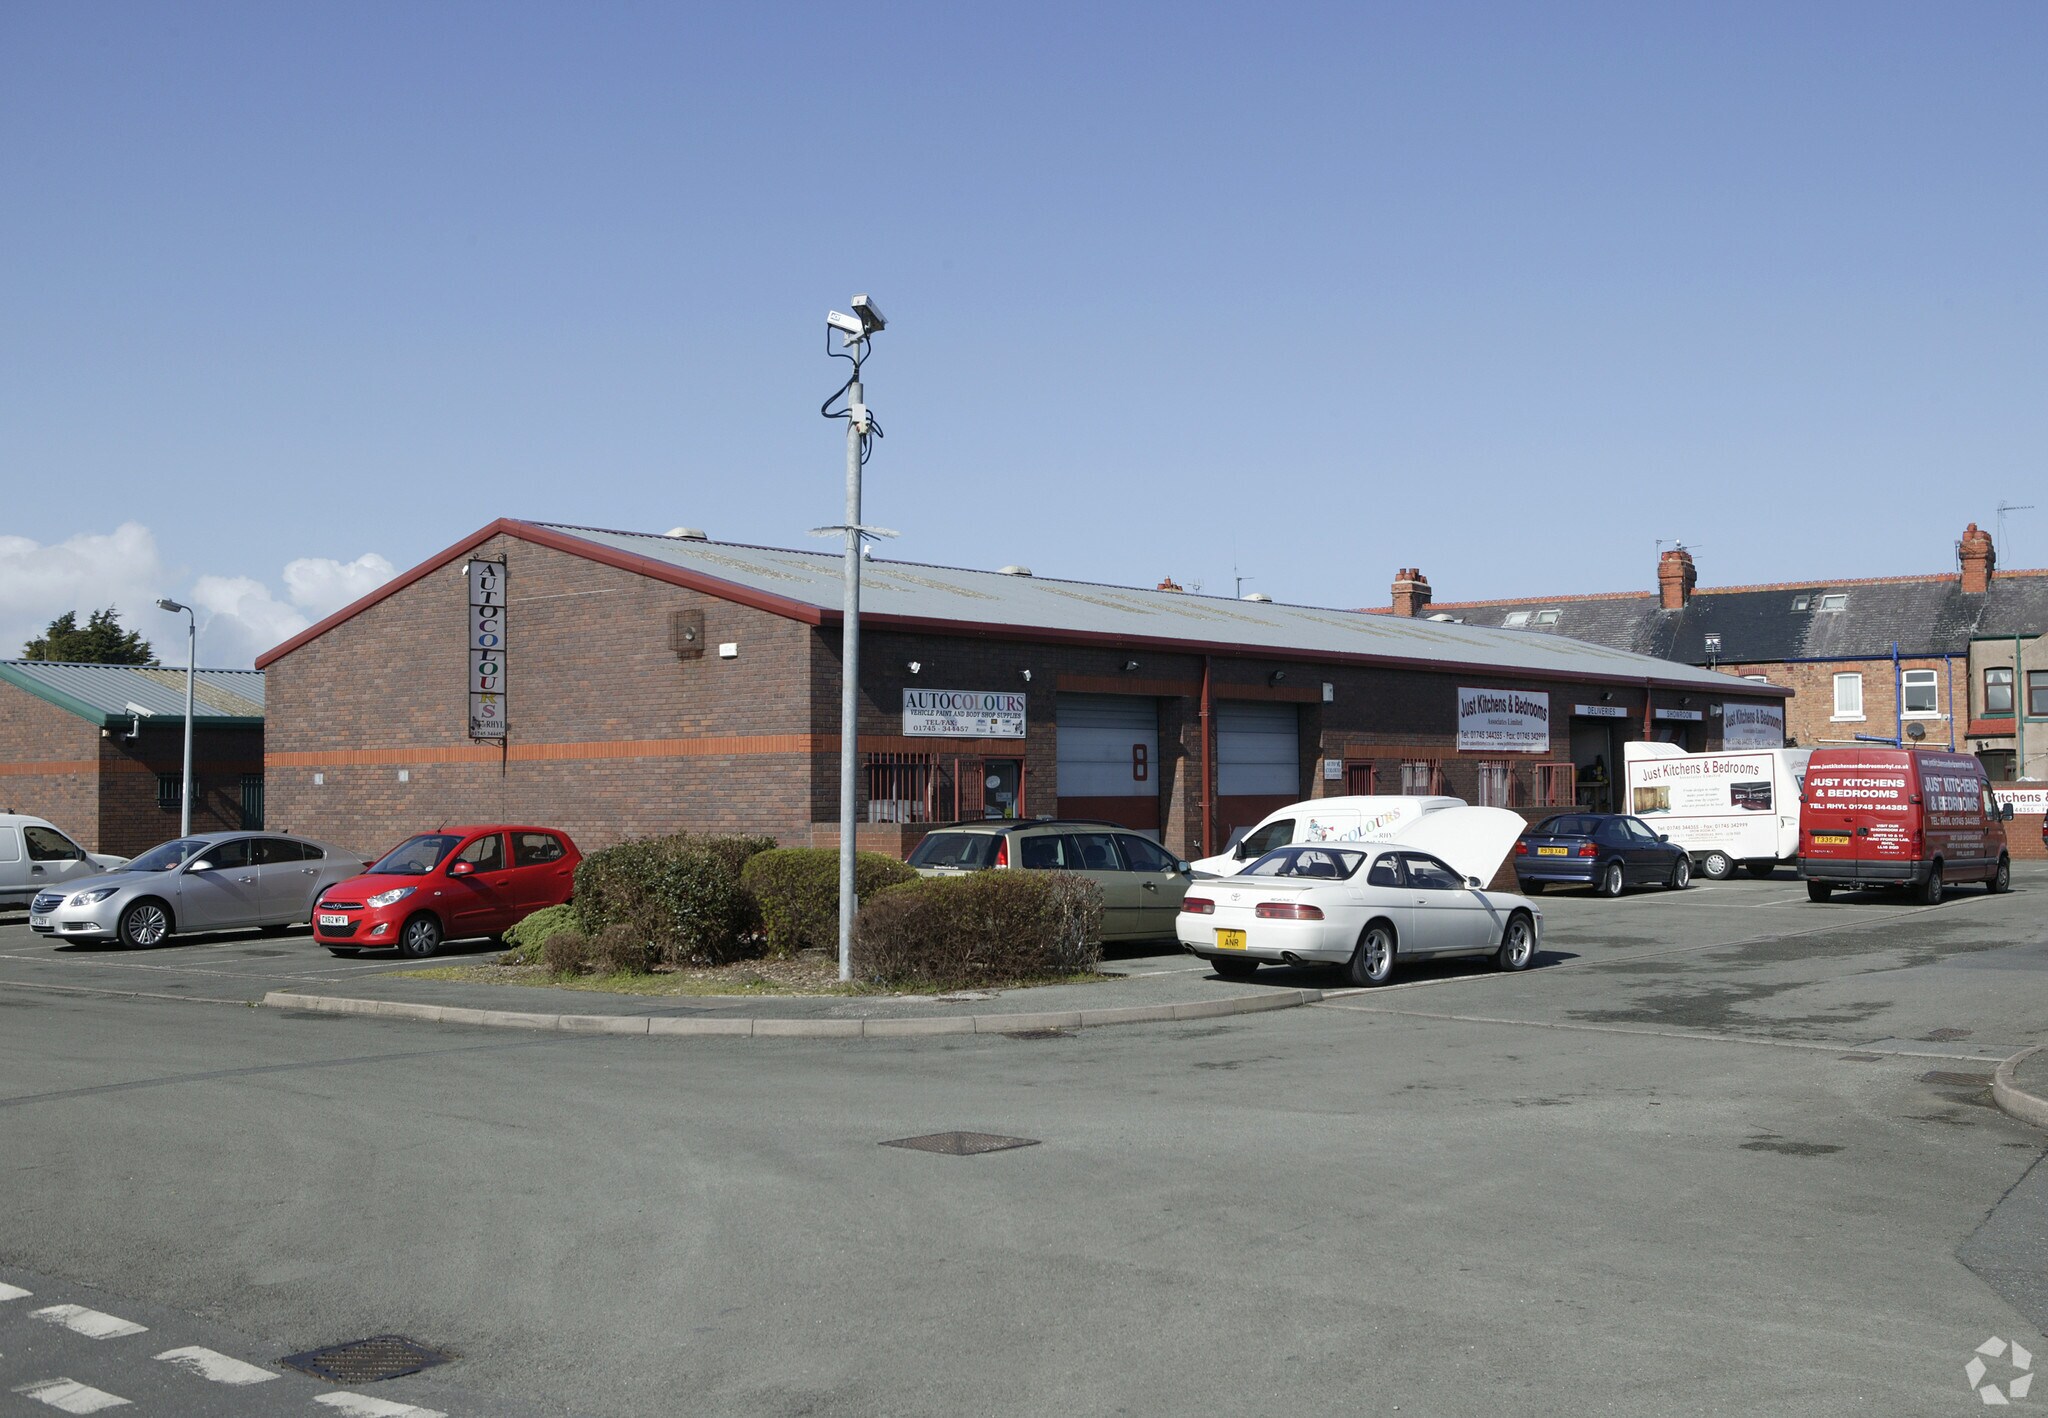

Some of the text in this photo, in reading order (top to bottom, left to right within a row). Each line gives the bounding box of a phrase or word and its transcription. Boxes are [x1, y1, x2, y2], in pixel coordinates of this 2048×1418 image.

[478, 564, 499, 718] AUTOCOLOURS
[905, 692, 1024, 712] AUTOCOLOURS
[1461, 694, 1547, 722] Just Kitchens & Bedrooms
[911, 709, 934, 717] VEHICLE
[935, 709, 953, 718] PAINT
[952, 710, 965, 718] AND
[981, 711, 996, 719] SHOP
[1587, 706, 1616, 716] DELIVERIES
[1666, 710, 1692, 719] SHOWROOM
[486, 720, 505, 729] RHYL
[1507, 718, 1523, 726] Limited
[1725, 711, 1736, 728] Just
[1735, 709, 1755, 725] Kitchens
[1760, 709, 1781, 731] Bedrooms
[1470, 731, 1485, 739] 01745
[1486, 731, 1502, 740] 344355
[1516, 732, 1530, 741] 01745
[1133, 744, 1148, 781] 8
[1643, 760, 1760, 782] Just Kitchens & Bedrooms
[1811, 778, 1905, 788] JUST KITCHENS
[1924, 776, 1979, 793] JUST KITCHENS
[1816, 789, 1898, 798] & BEDROOMS
[1931, 796, 1978, 811] & BEDROOMS
[1334, 807, 1401, 843] COLOURS
[1224, 938, 1239, 947] ANR
